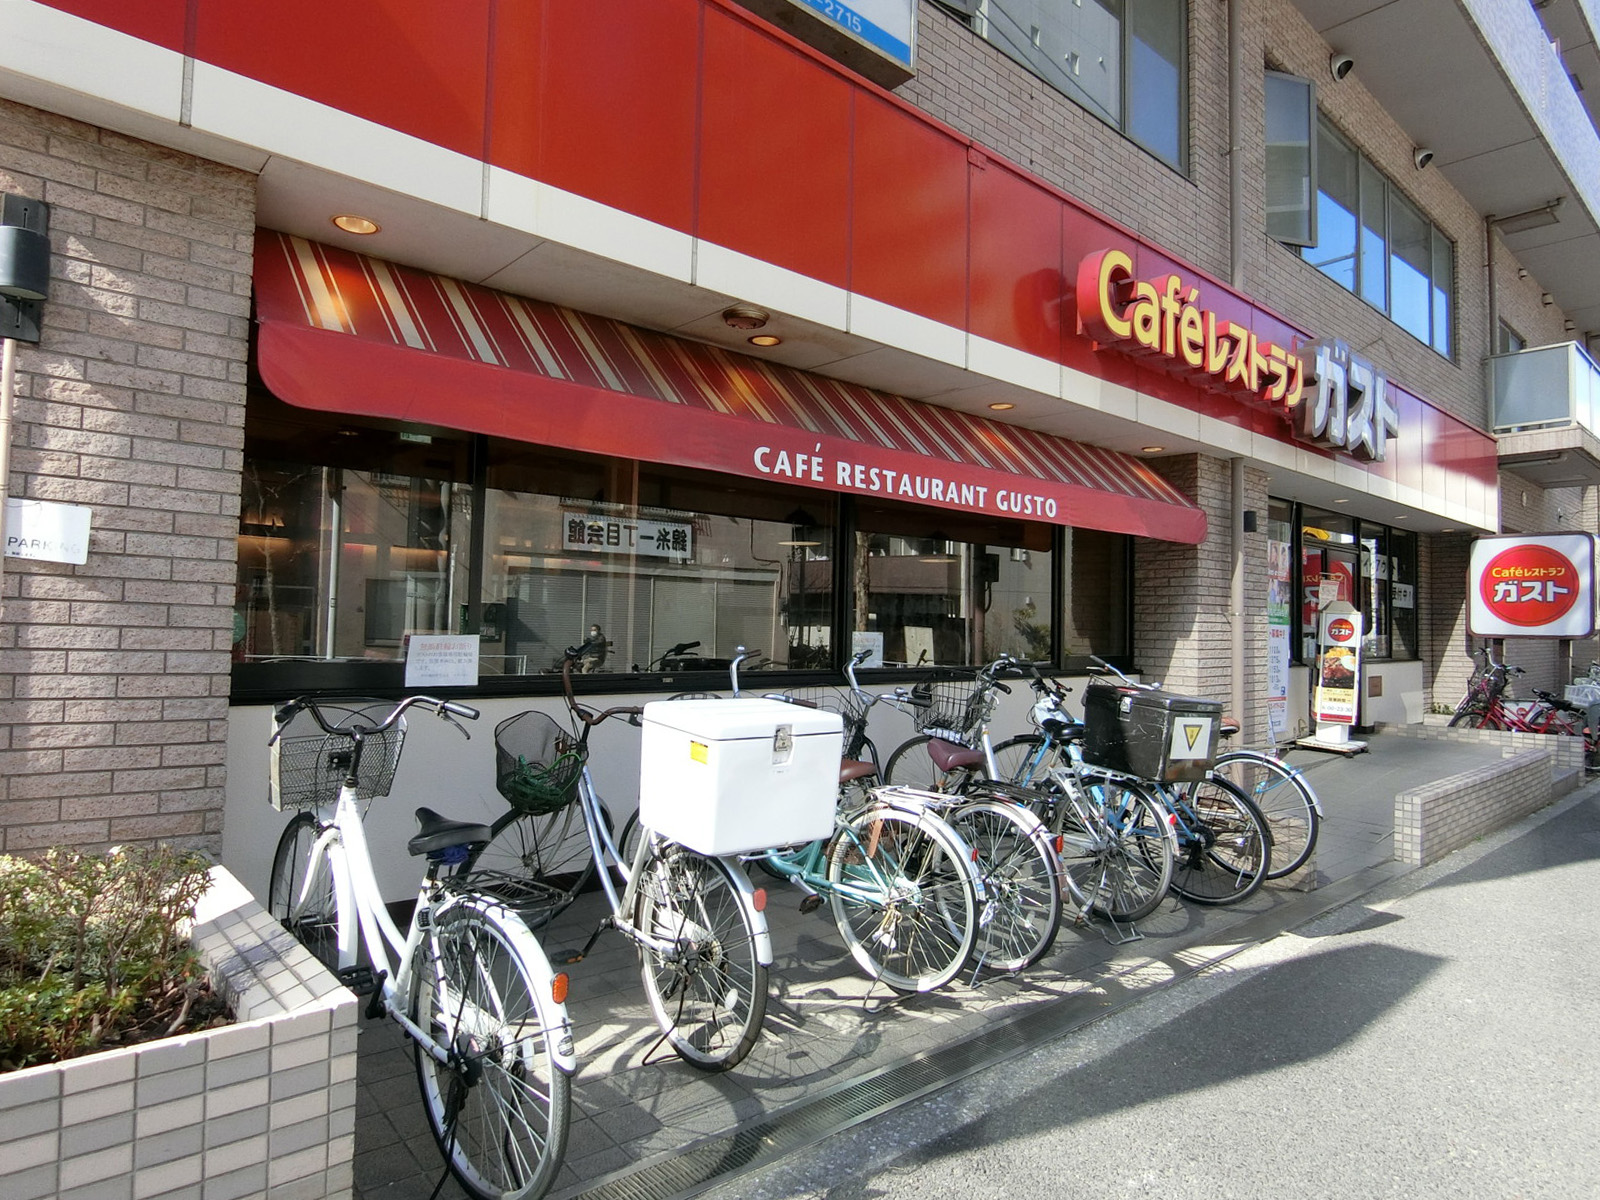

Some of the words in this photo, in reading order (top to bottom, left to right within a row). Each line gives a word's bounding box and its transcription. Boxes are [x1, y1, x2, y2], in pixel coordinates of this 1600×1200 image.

[807, 0, 862, 33] -2715
[1312, 344, 1399, 462] ガスト
[753, 442, 824, 482] CAFÉ
[836, 461, 988, 507] RESTAURANT
[996, 490, 1057, 518] GUSTO
[1493, 580, 1569, 602] ガスト
[1330, 628, 1352, 636] ガスト
